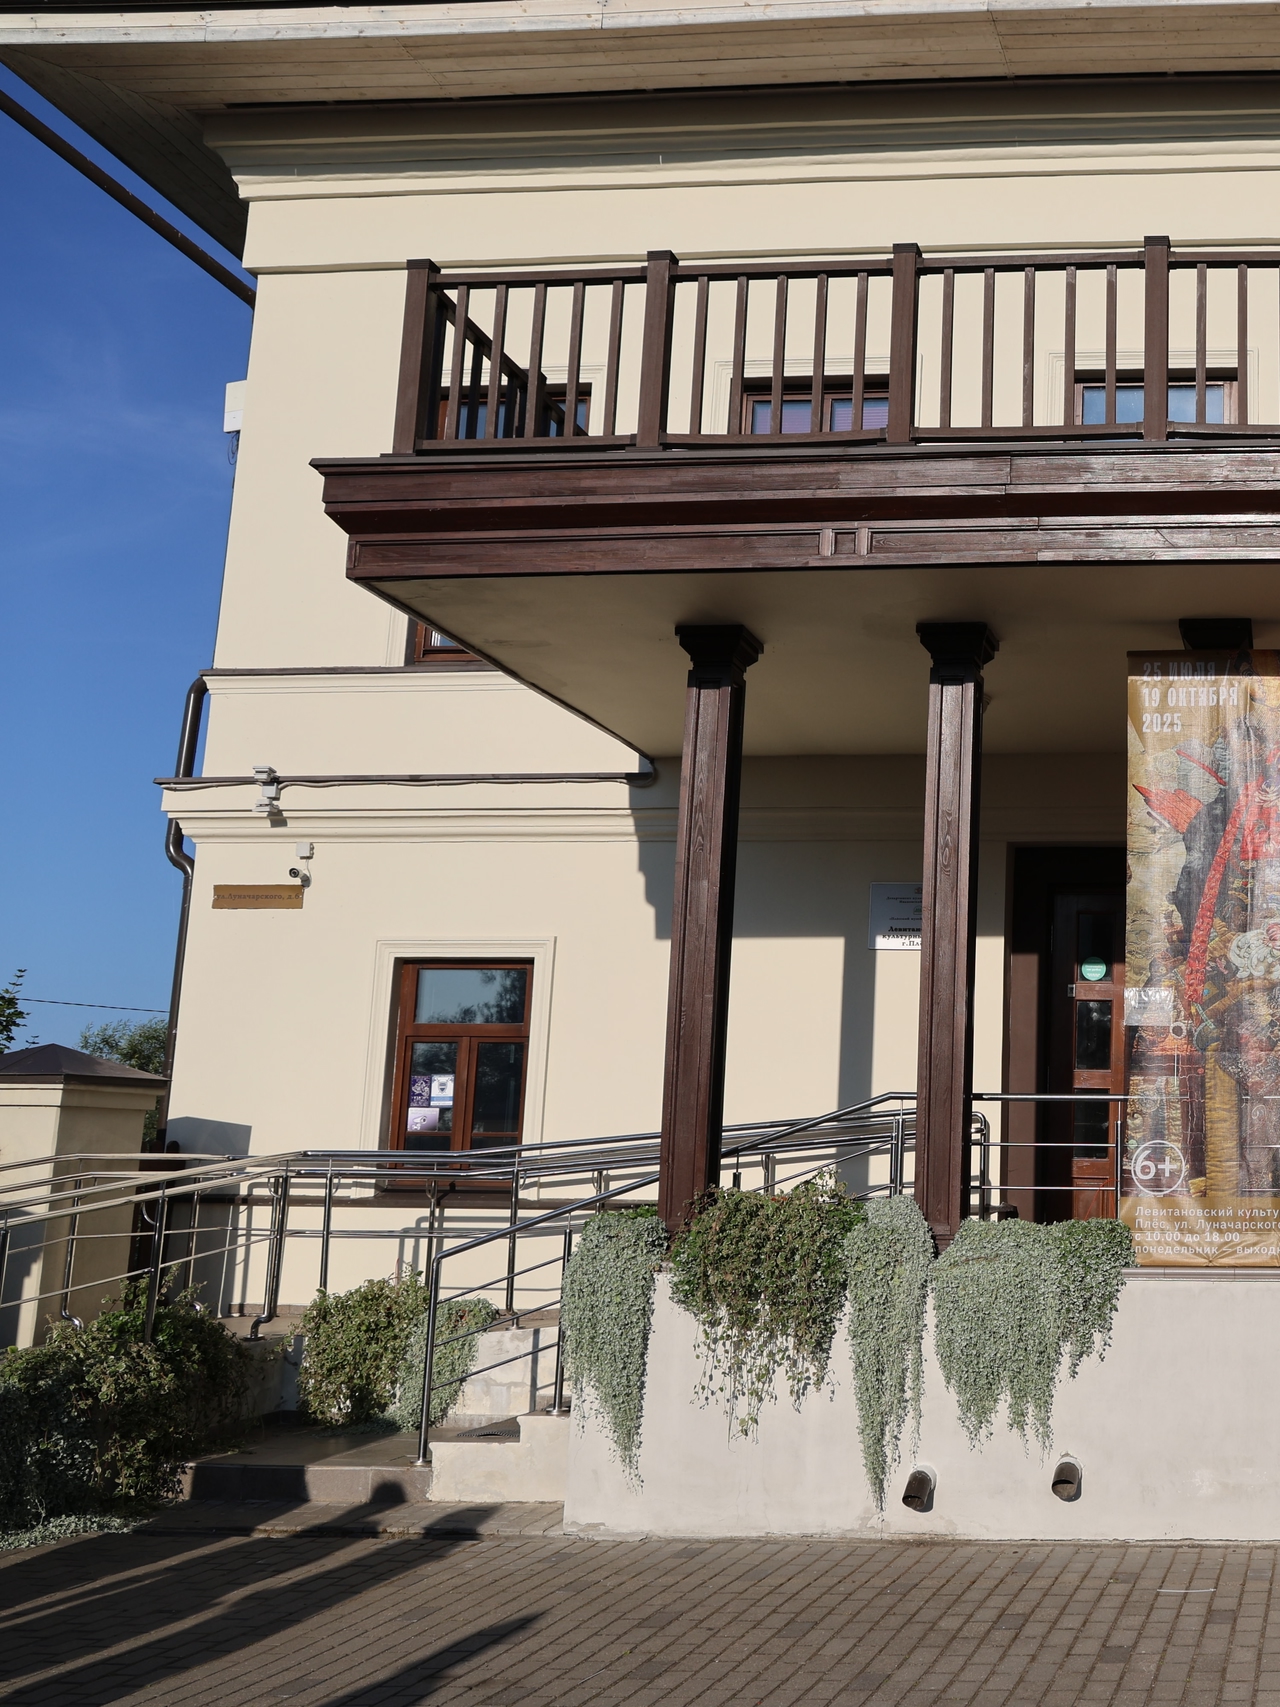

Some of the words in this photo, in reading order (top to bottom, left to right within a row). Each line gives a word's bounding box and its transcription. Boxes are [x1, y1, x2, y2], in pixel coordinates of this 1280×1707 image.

[1143, 662, 1162, 682] 25
[1169, 662, 1216, 681] ИЮЛЯ
[1142, 687, 1160, 707] 19
[1167, 687, 1238, 707] ОКТЯБРЯ
[1142, 713, 1182, 732] 2025
[1135, 1150, 1177, 1180] 6+
[1135, 1206, 1233, 1217] Левитановский
[1135, 1218, 1170, 1230] Плёс,
[1174, 1220, 1192, 1231] ул.
[1134, 1232, 1142, 1241] с
[1145, 1231, 1181, 1242] 10.00
[1184, 1233, 1200, 1242] до
[1204, 1231, 1240, 1242] 18.00
[1135, 1245, 1219, 1255] понедельник
